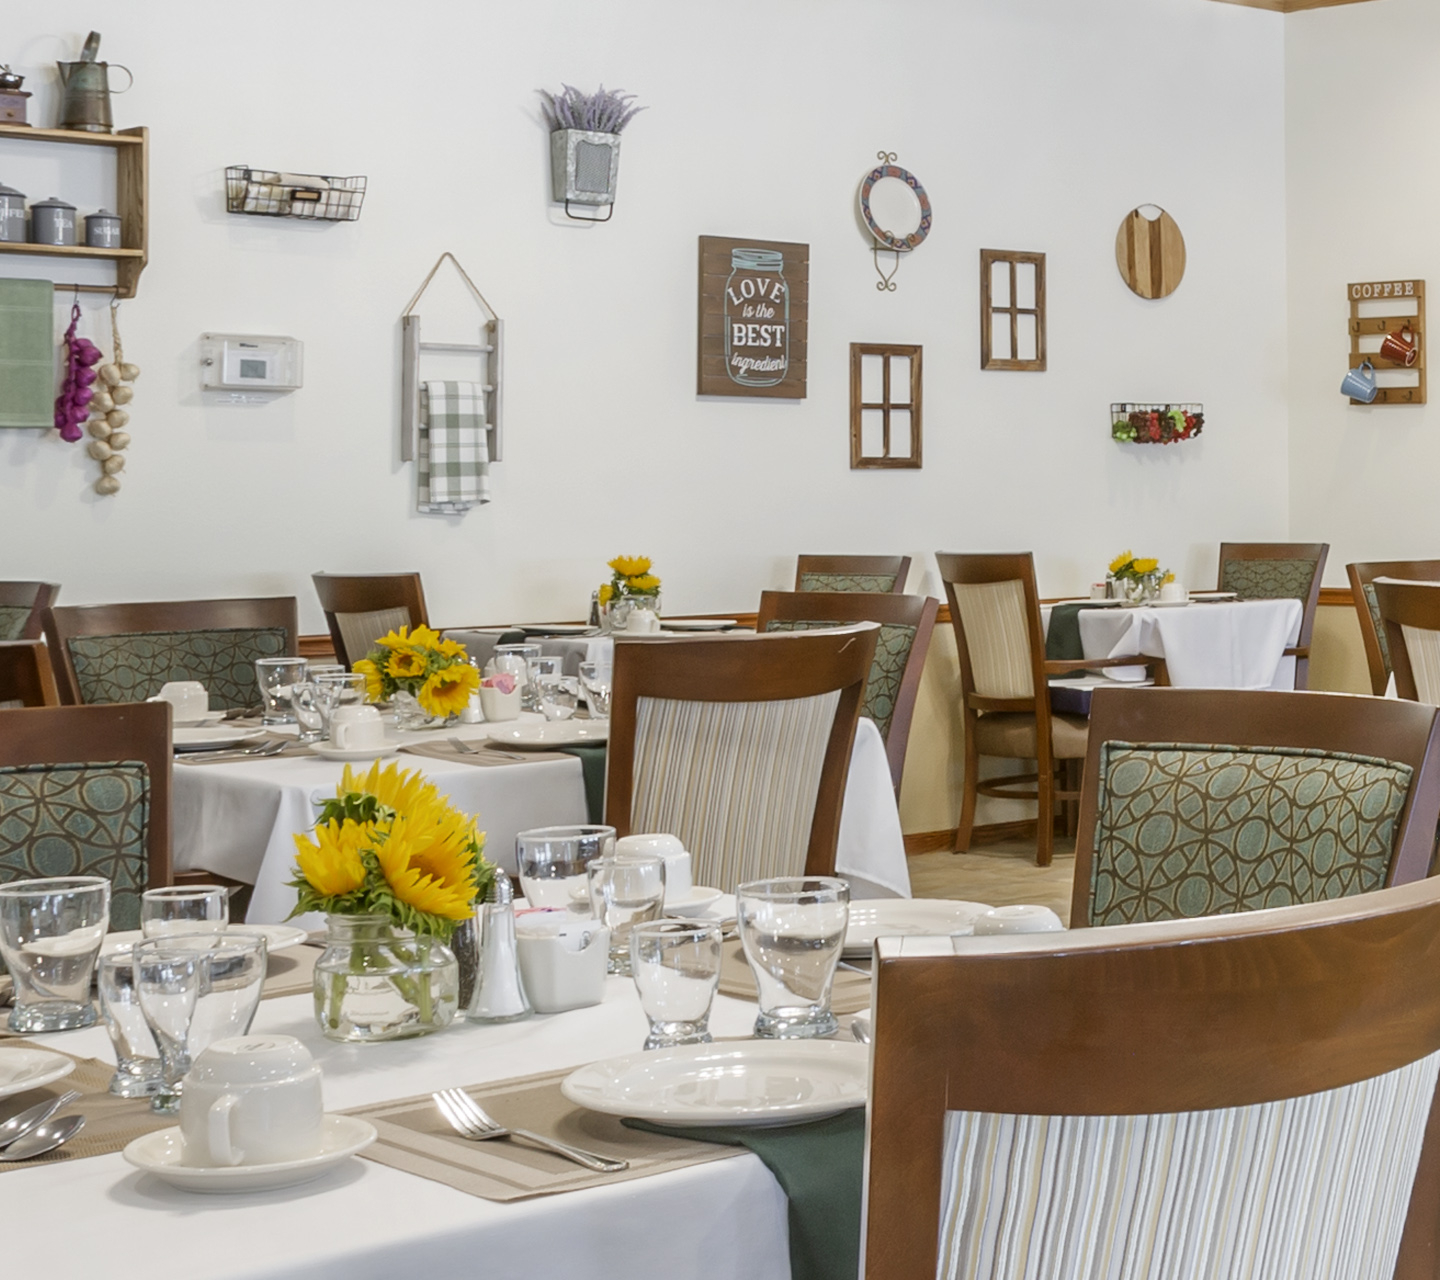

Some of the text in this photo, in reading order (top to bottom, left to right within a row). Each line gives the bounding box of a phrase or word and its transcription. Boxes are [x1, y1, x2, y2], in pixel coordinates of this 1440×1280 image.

[727, 278, 786, 306] LOVE
[1352, 282, 1414, 298] COFFEE
[742, 302, 775, 319] is the
[732, 323, 786, 347] BEST
[731, 352, 786, 375] ingredient
